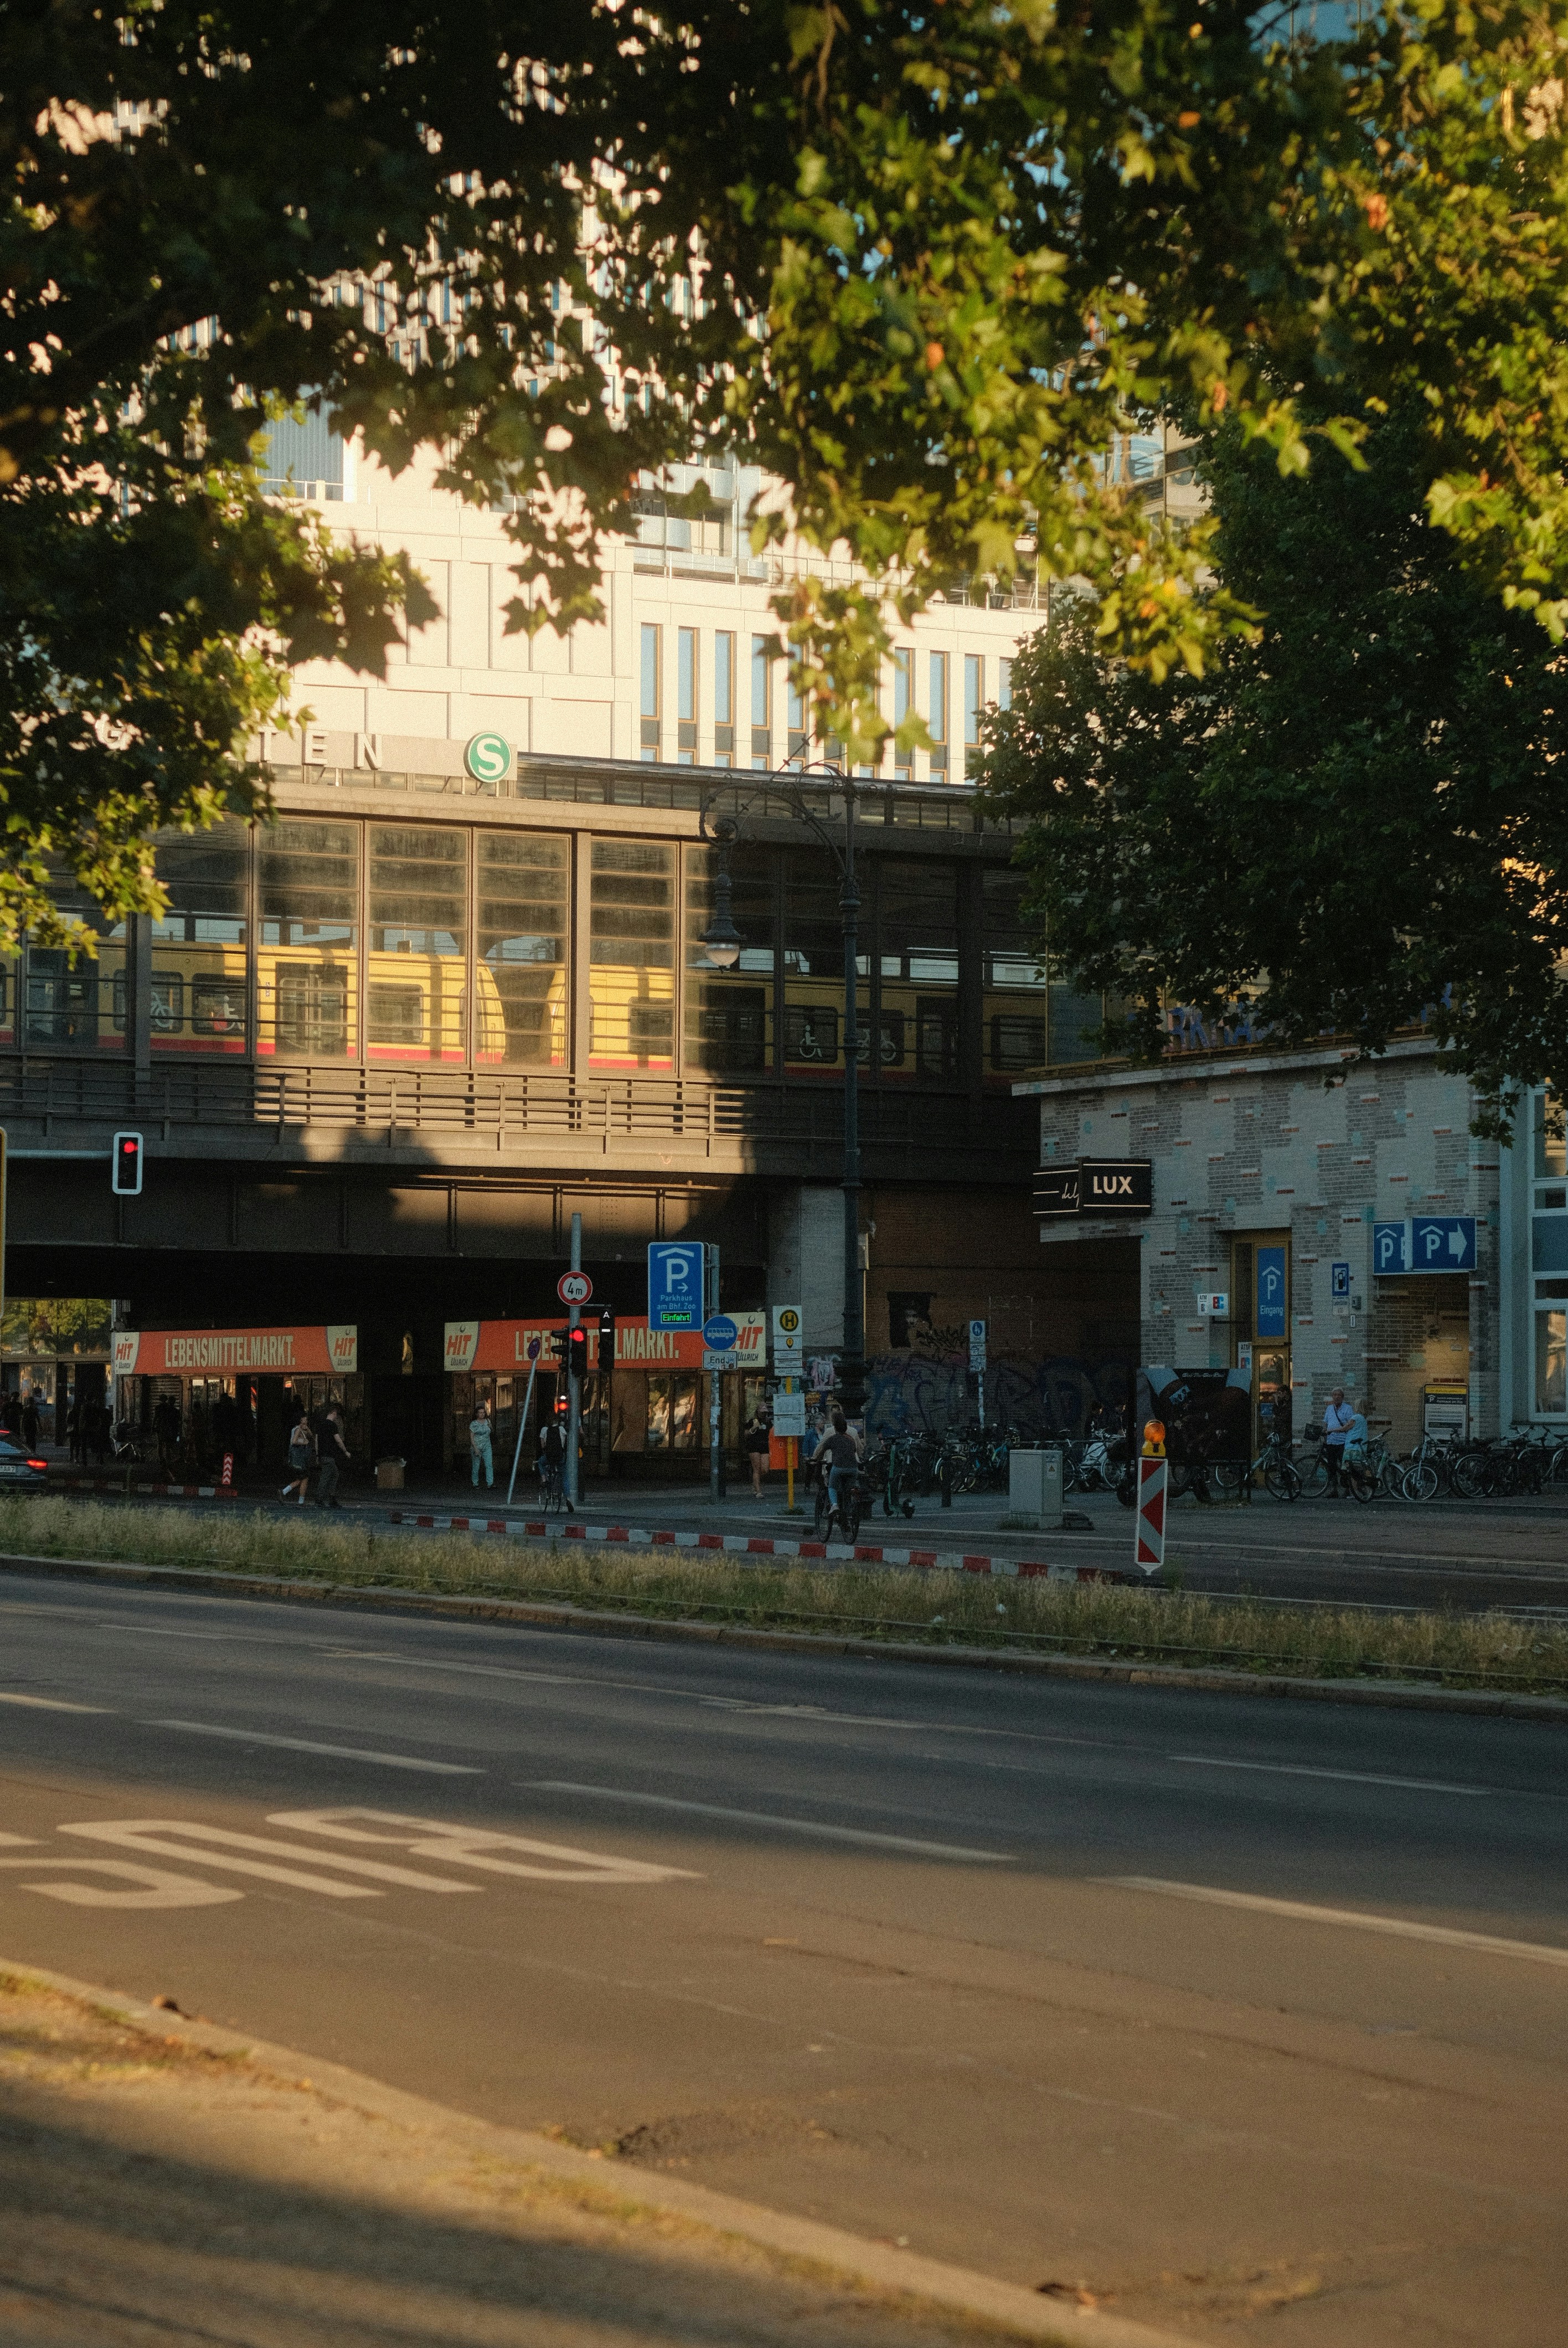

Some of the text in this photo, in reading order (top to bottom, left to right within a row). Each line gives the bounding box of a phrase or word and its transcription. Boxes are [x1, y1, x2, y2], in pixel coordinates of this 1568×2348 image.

[256, 725, 381, 770] TEN
[477, 738, 504, 776] S
[1093, 1176, 1133, 1194] LUX
[1381, 1238, 1394, 1268] P
[1426, 1234, 1441, 1259] P
[666, 1258, 689, 1293] P
[568, 1282, 574, 1295] 4
[1267, 1275, 1277, 1300] P
[662, 1313, 690, 1321] Einfahrt
[785, 1315, 794, 1327] H
[1260, 1305, 1283, 1316] Eingang
[334, 1337, 355, 1356] HIT
[446, 1335, 472, 1356] HIT
[731, 1326, 763, 1350] HIT
[116, 1343, 133, 1360] HIT
[166, 1335, 296, 1367] LEBENSMITTELMARKT.
